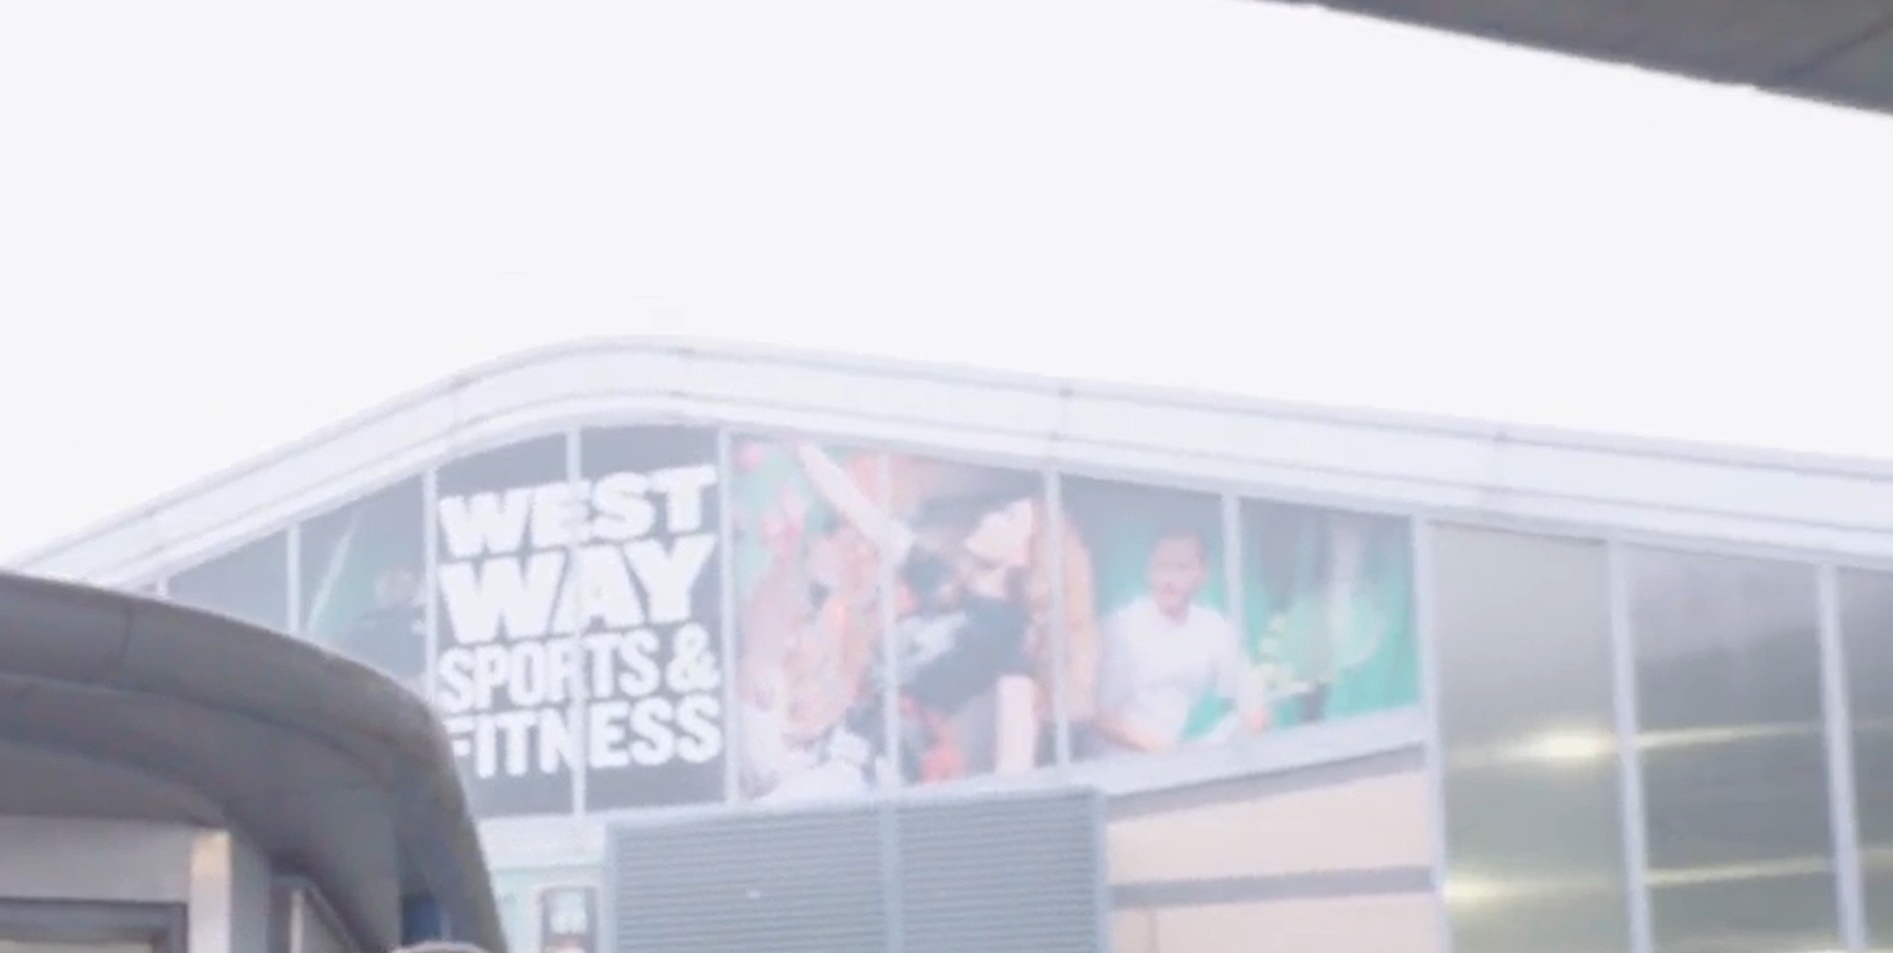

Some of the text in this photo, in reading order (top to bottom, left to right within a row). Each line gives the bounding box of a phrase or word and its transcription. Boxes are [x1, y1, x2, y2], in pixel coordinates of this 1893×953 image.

[440, 465, 716, 558] WEST
[441, 533, 715, 644] WAY
[439, 622, 721, 712] SPORTS &
